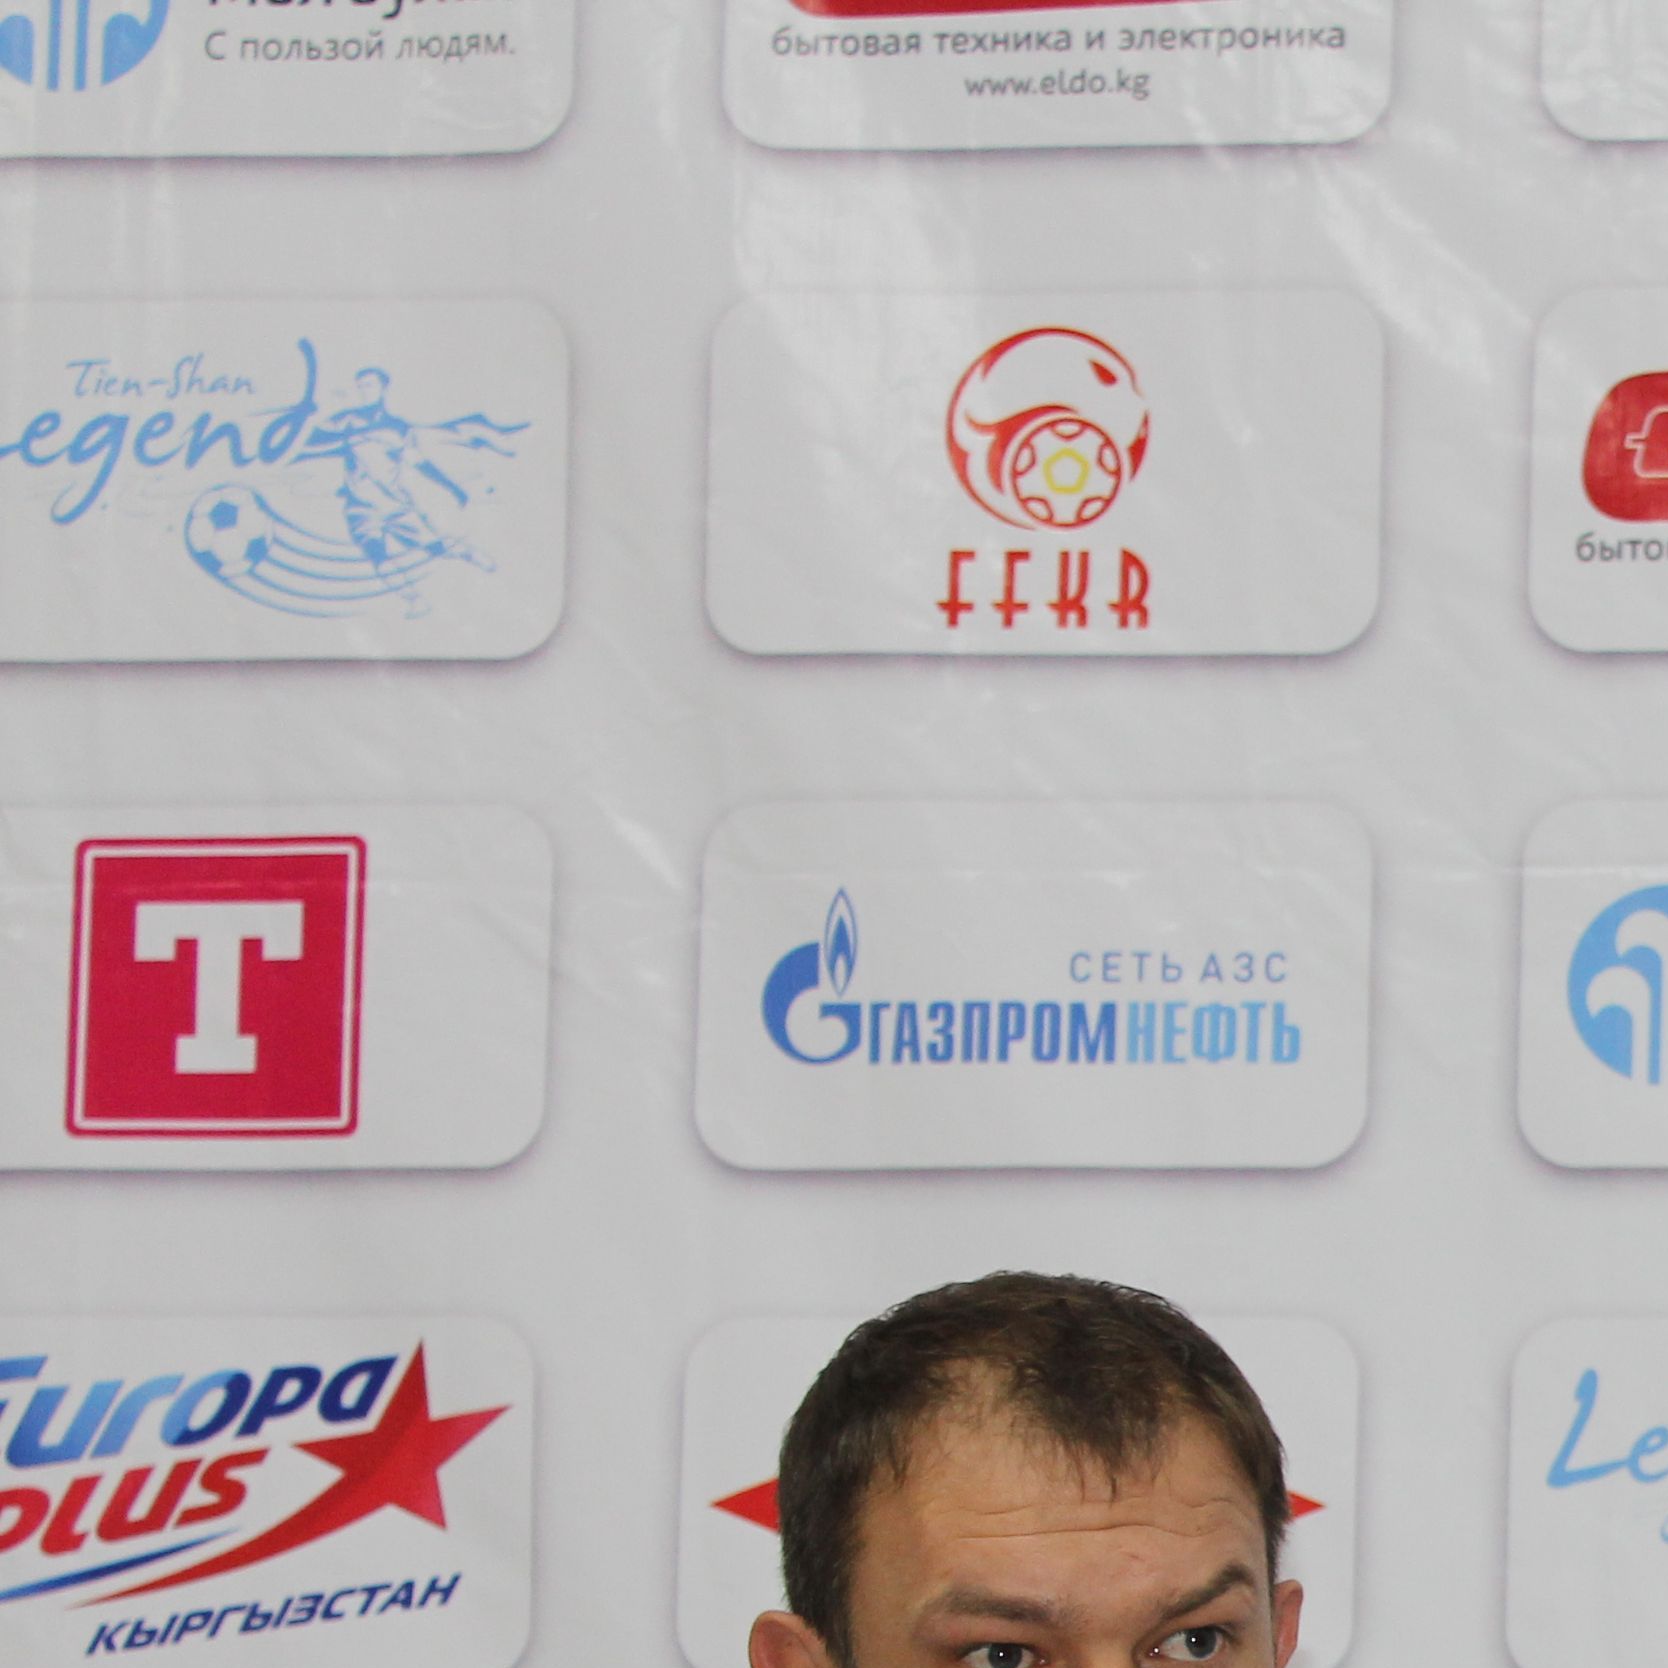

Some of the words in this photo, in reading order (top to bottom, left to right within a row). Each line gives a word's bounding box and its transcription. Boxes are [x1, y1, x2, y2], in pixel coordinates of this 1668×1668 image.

[204, 30, 227, 62] С
[240, 29, 385, 62] пользой
[395, 33, 515, 63] людям.
[771, 25, 923, 58] бытовая
[932, 28, 1073, 55] техника
[1084, 30, 1106, 51] и
[1118, 24, 1347, 54] электроника
[963, 68, 1151, 101] www.eldo.kg
[66, 353, 256, 399] Tien-Shan
[0, 338, 318, 525] egend
[938, 549, 1151, 629] FFKR
[1069, 950, 1184, 985] СЕТЬ
[1199, 950, 1287, 985] АЗС
[868, 1000, 1302, 1066] ГАЗПРОМНЕФТЬ
[85, 1574, 461, 1656] КЫРГЫЗСТАН
